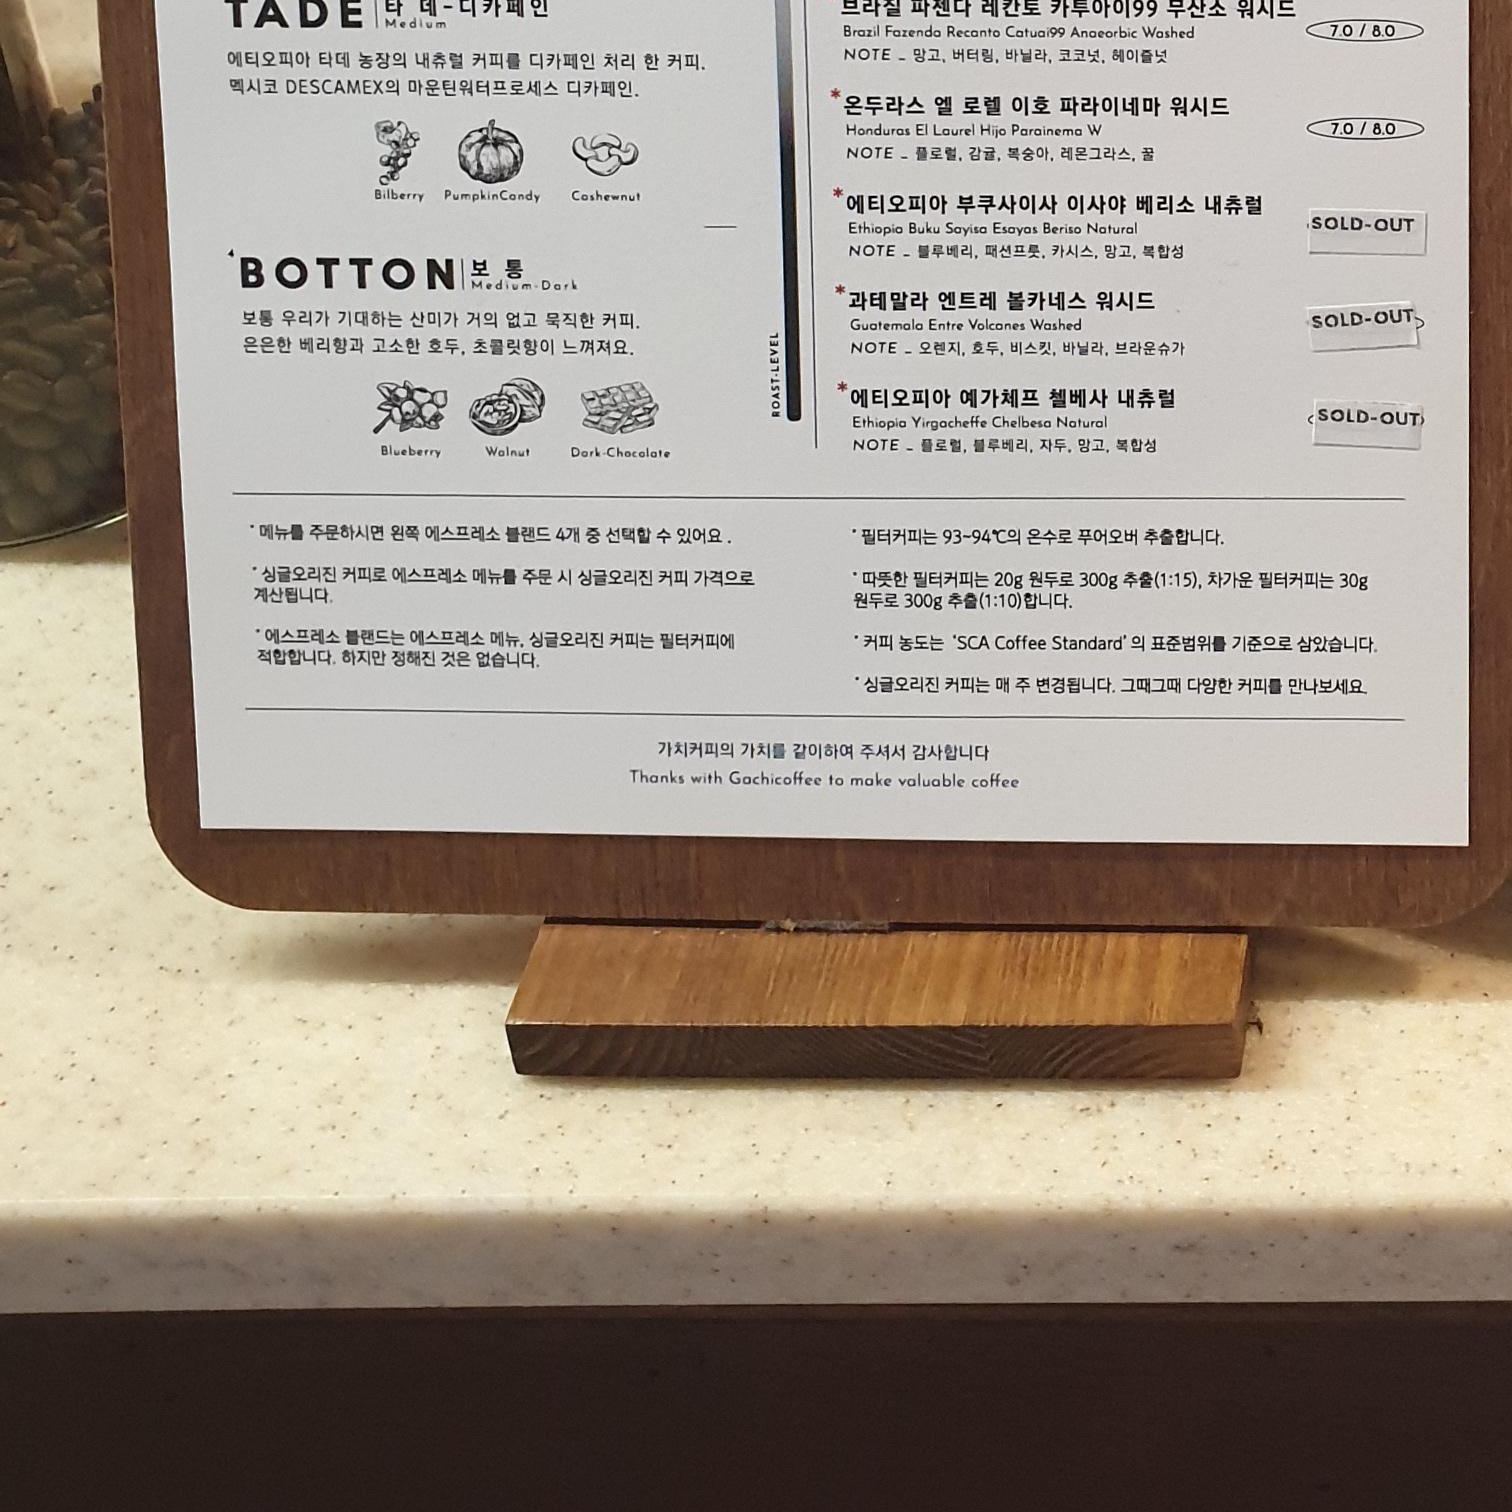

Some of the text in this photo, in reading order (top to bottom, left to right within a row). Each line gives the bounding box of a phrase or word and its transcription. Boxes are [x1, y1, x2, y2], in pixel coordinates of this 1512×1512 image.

[375, 188, 640, 203] Bilberry PumpkinCandy Cashewnut
[1312, 216, 1415, 232] SOLD-OUT
[240, 257, 454, 290] BOTTON
[1312, 308, 1415, 328] SOLD-OUT
[770, 332, 780, 417] ROAST-LEVEL
[1318, 408, 1420, 426] SOLD-OUT
[381, 445, 670, 458] Blueberry Walnut Dark-Chocolate
